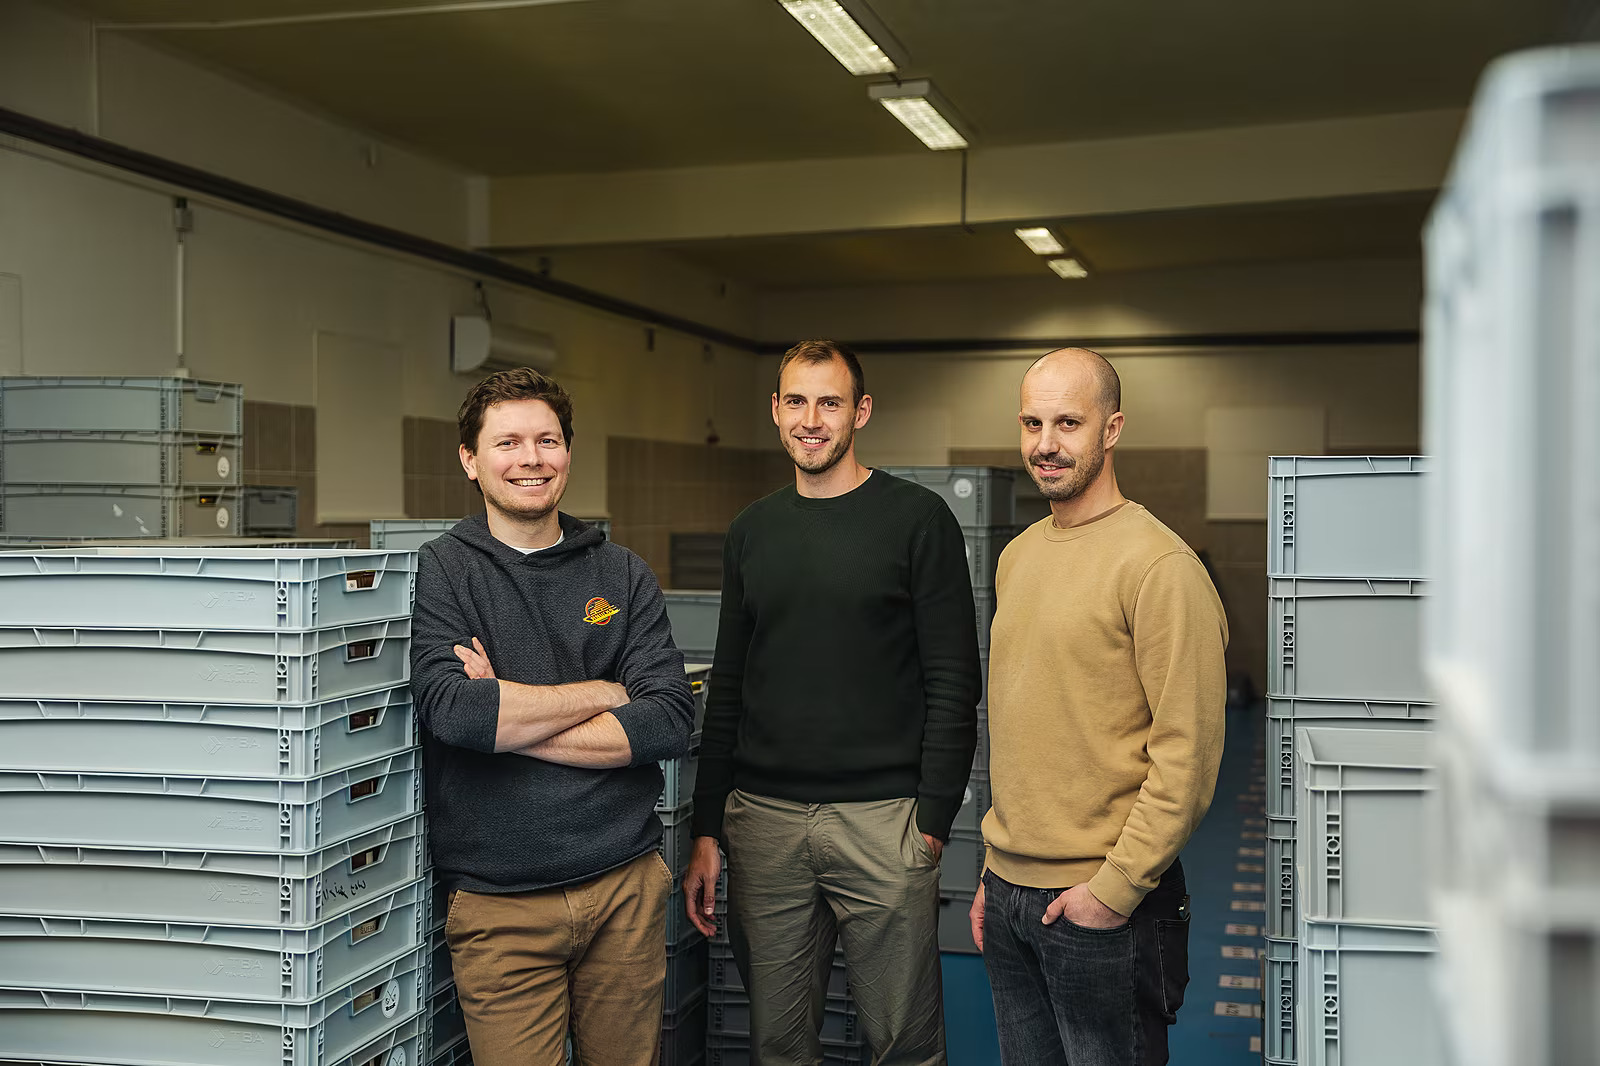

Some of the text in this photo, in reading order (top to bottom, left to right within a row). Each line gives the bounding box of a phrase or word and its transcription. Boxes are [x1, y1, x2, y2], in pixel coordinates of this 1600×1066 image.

[223, 663, 258, 676] TBA
[227, 883, 263, 896] TBA
[227, 957, 264, 970] TBA
[229, 1031, 265, 1044] TBA
